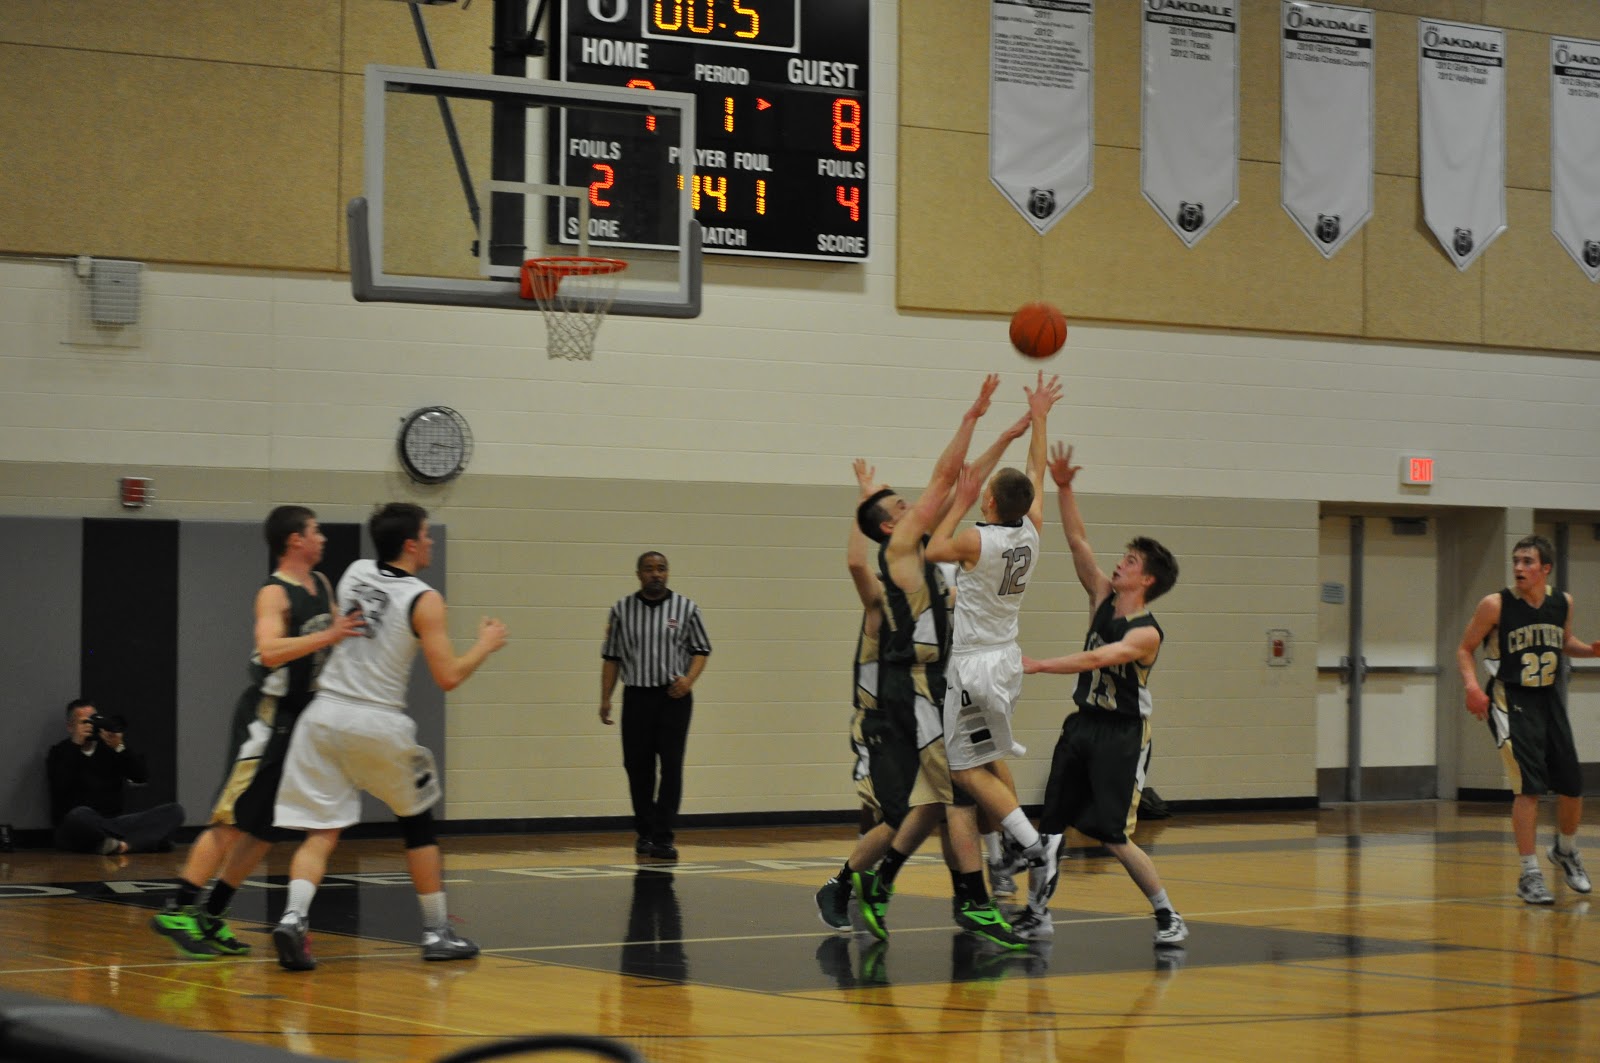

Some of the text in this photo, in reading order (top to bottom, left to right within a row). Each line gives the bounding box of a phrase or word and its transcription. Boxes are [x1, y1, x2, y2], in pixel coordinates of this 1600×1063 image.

[1148, 0, 1233, 17] OAKDALE
[1287, 12, 1369, 33] OAKDALE
[582, 37, 650, 69] HOME
[1423, 31, 1500, 53] OAKDALE
[695, 64, 750, 86] PERIOD
[787, 58, 859, 88] GUEST
[724, 97, 734, 132] 1
[833, 98, 860, 151] 8
[569, 138, 621, 160] FOULS
[668, 147, 774, 172] PYER FOUL
[817, 158, 866, 180] FOULS
[588, 163, 614, 208] 2
[756, 179, 766, 215] 1
[836, 185, 860, 222] 4
[567, 216, 621, 238] SORE
[817, 233, 866, 255] SCORE
[1410, 457, 1434, 482] EXIT
[998, 545, 1032, 596] 12
[1520, 651, 1558, 688] 22
